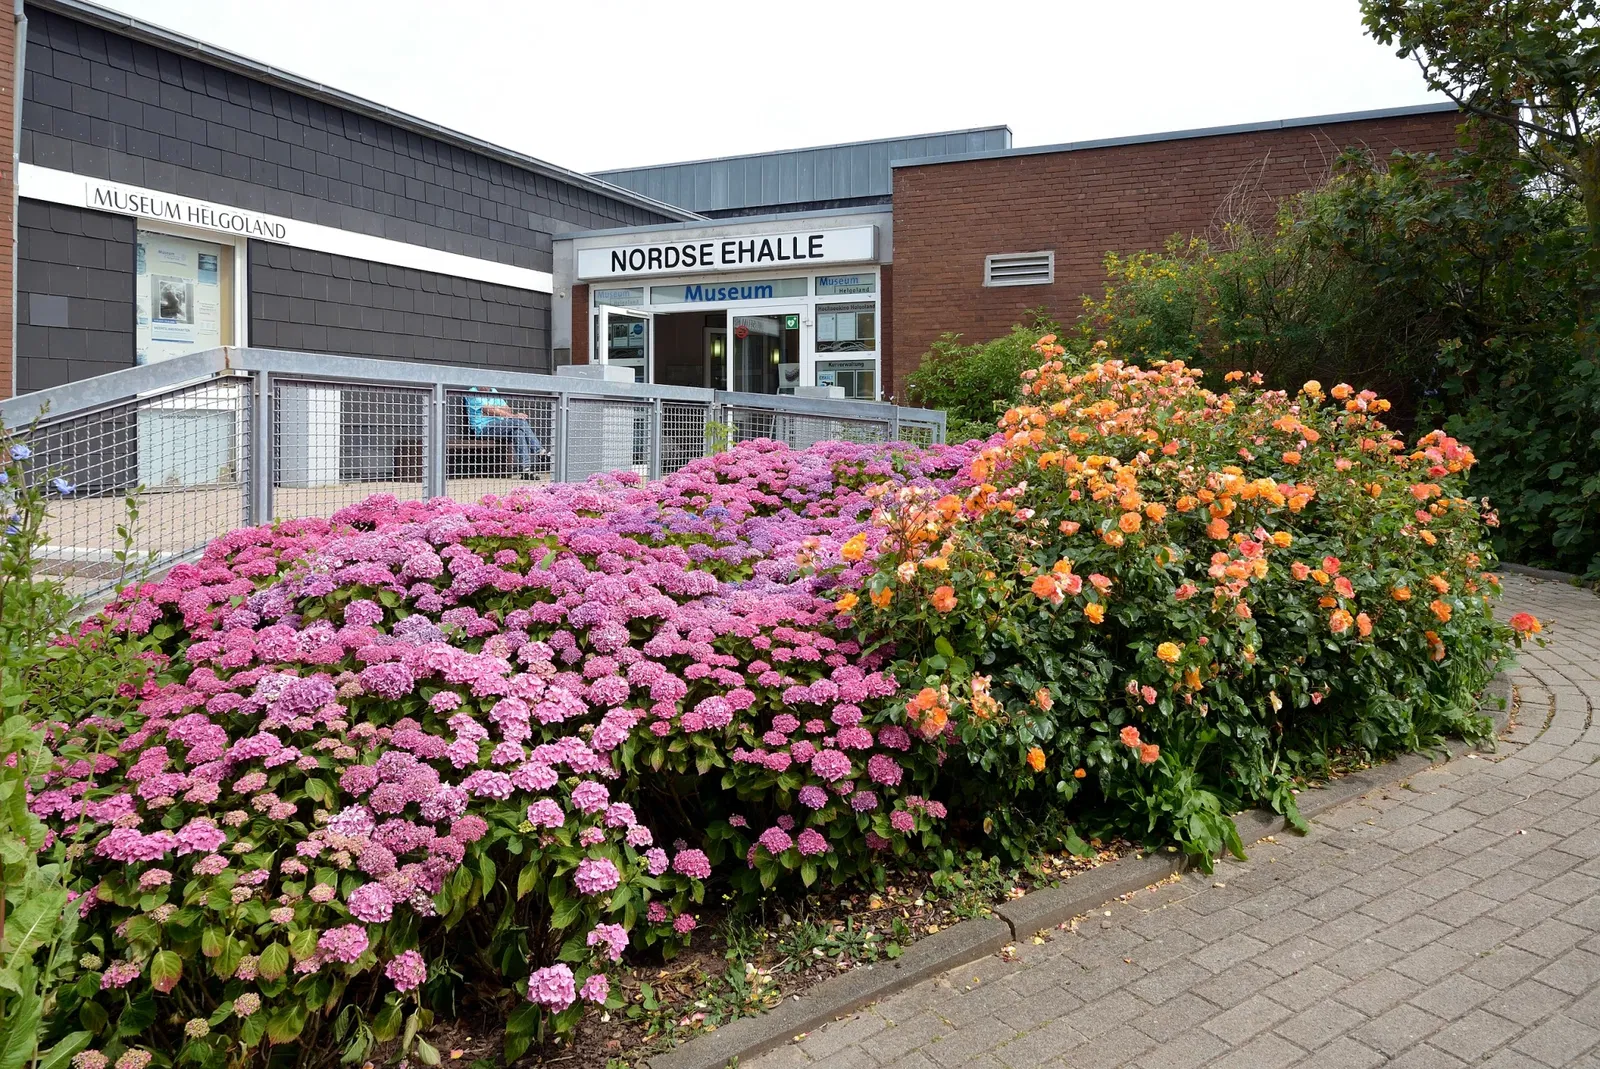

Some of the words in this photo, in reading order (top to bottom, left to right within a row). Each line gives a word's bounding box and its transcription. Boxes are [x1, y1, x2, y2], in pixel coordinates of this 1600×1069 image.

[94, 187, 182, 221] MUSEUM
[187, 205, 287, 240] HELGOLAND
[819, 276, 859, 286] Museum
[598, 290, 630, 299] Museum
[684, 284, 773, 302] Museum
[839, 286, 870, 294] Helgoland
